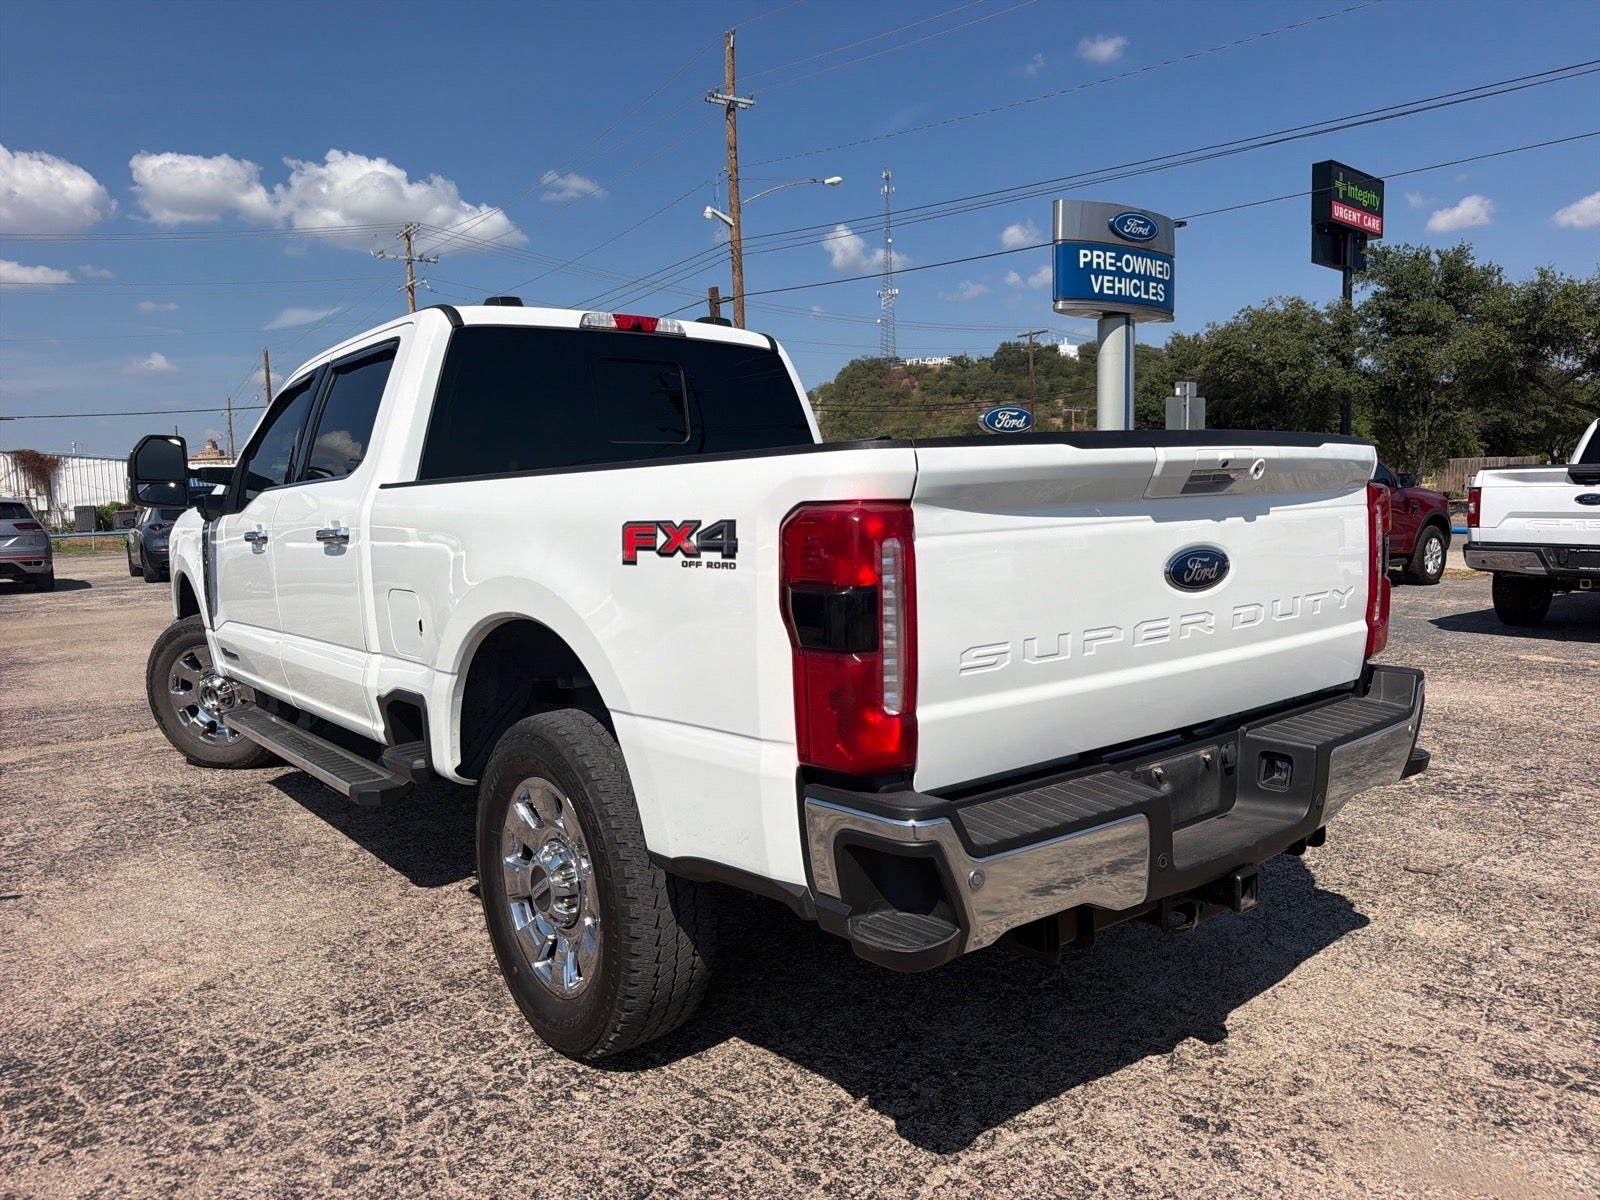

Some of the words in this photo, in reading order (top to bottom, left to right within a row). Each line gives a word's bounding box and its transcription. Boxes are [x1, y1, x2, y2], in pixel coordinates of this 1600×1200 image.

[1347, 181, 1380, 211] integrity
[1123, 218, 1150, 236] Ford
[1334, 204, 1361, 225] URGENT
[1363, 215, 1380, 231] CARE
[1079, 249, 1171, 281] PRE-OWNED
[1090, 274, 1165, 302] VEHICLES
[994, 411, 1026, 428] Ford
[622, 519, 738, 566] FX4
[681, 560, 702, 569] OFF
[706, 561, 736, 570] ROAD
[1183, 556, 1219, 582] Ford
[959, 610, 1215, 676] SUPER
[1233, 586, 1355, 630] DUTY
